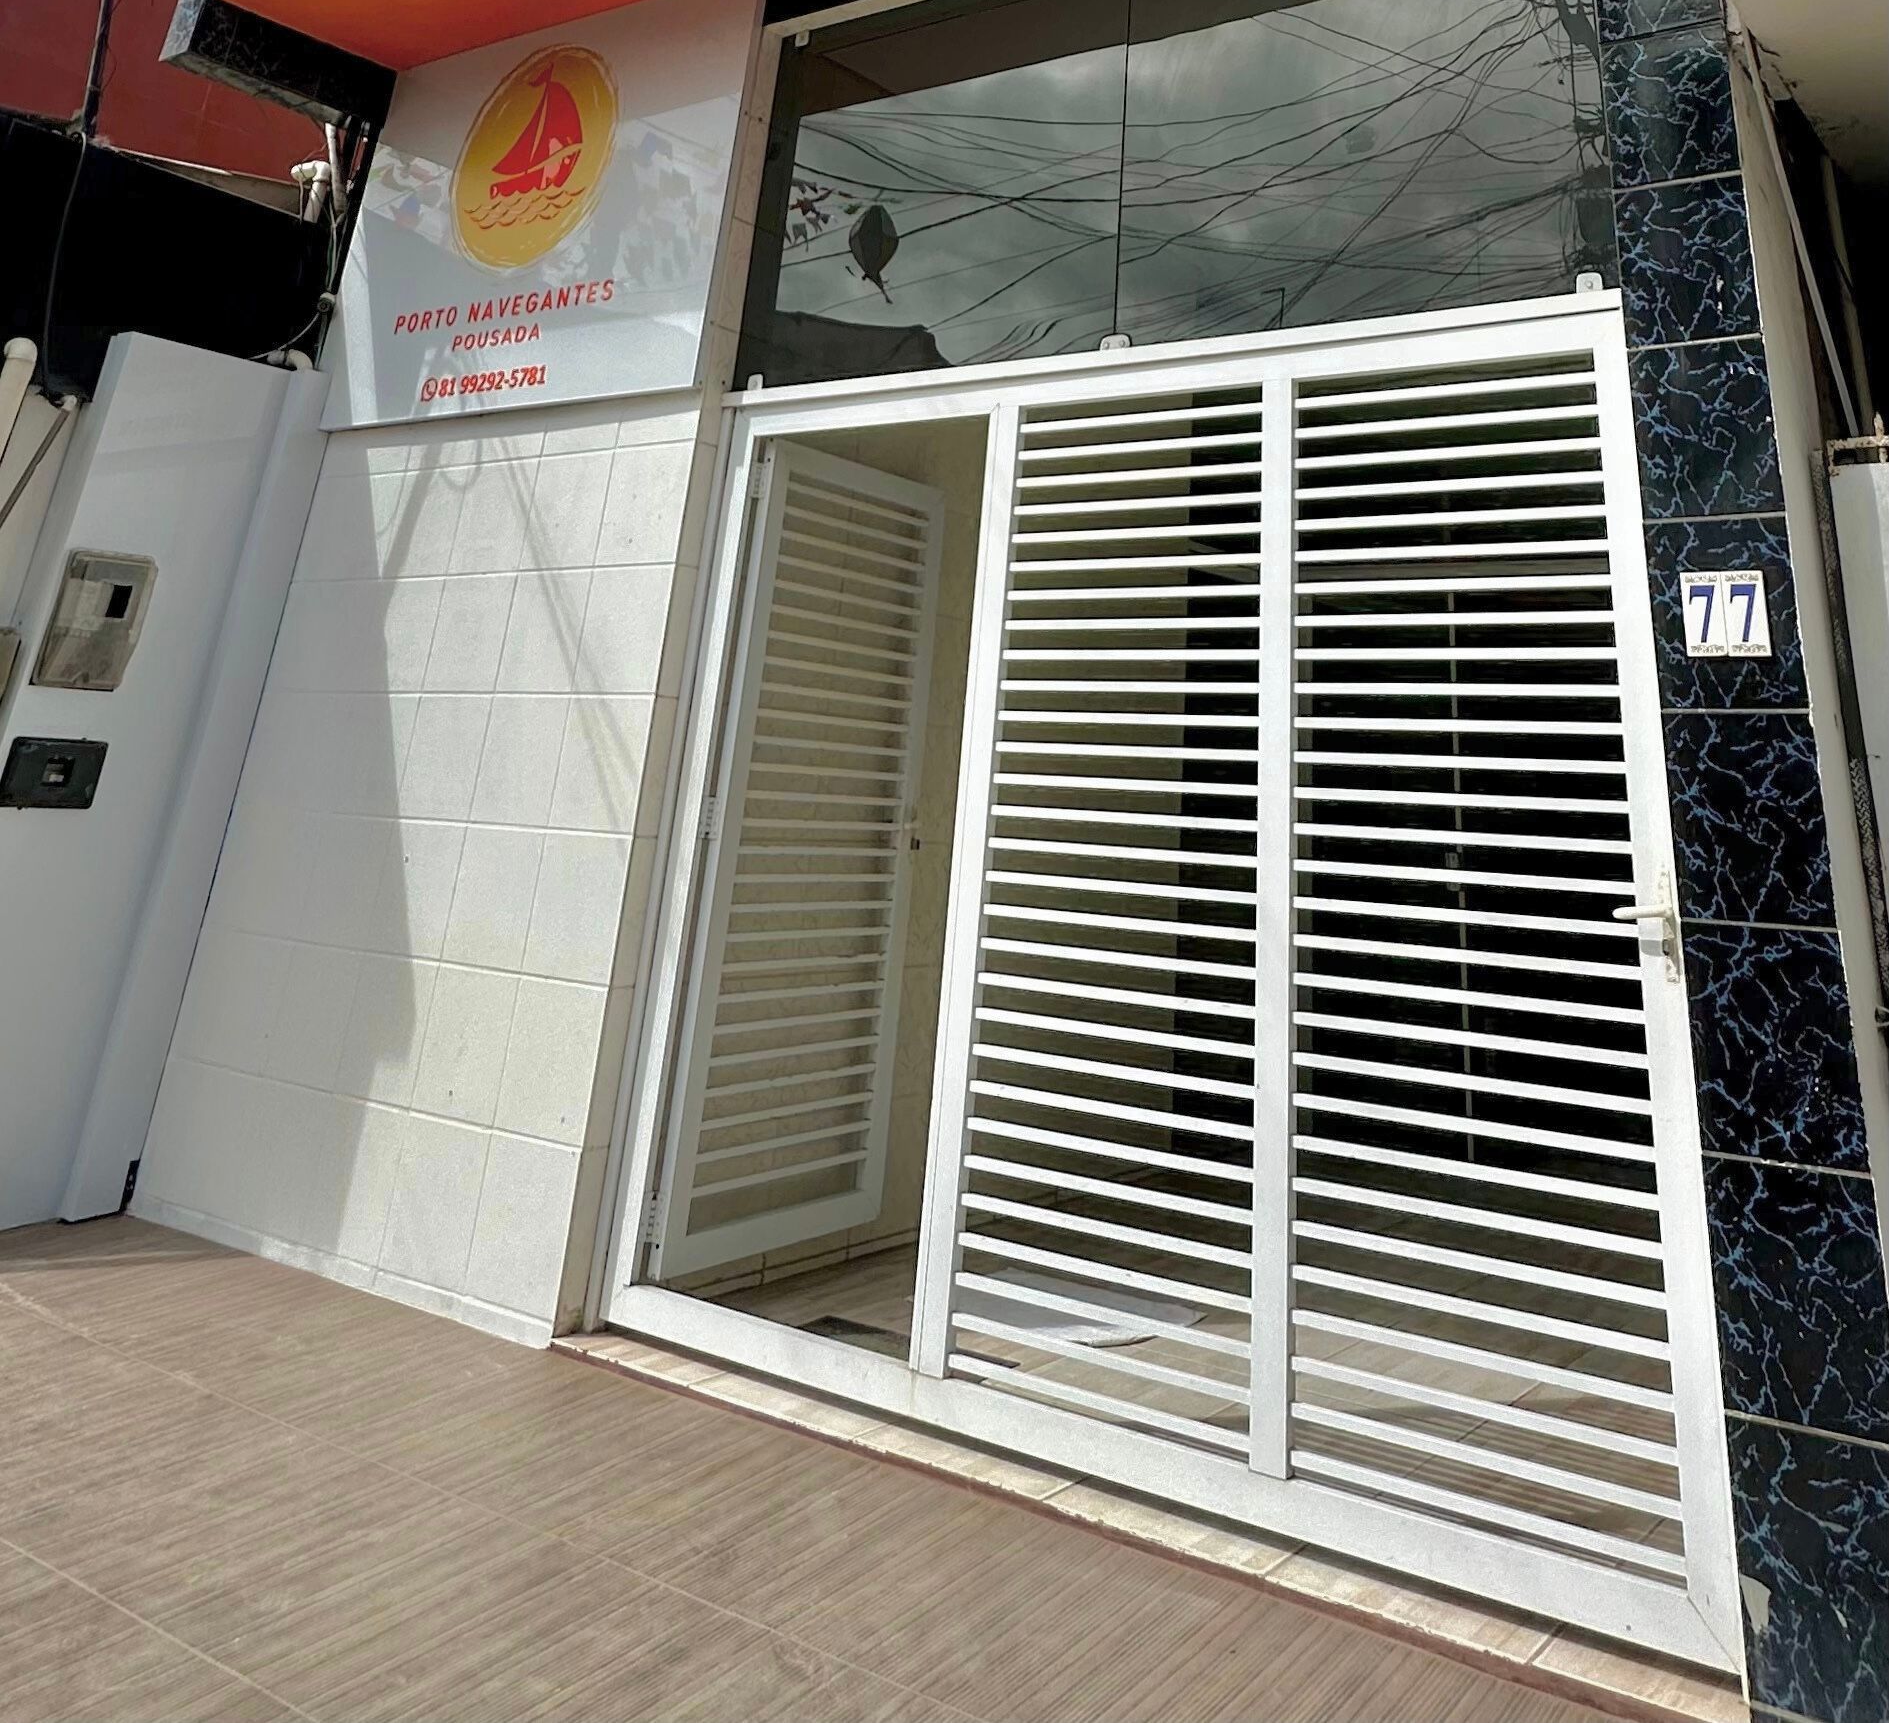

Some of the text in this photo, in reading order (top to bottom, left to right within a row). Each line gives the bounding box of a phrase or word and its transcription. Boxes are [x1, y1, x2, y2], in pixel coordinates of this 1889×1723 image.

[394, 279, 614, 334] PORTO NAVEGANTES
[452, 323, 540, 351] POUSADA
[438, 365, 547, 397] 81 99292-5781
[1688, 583, 1757, 643] 77
